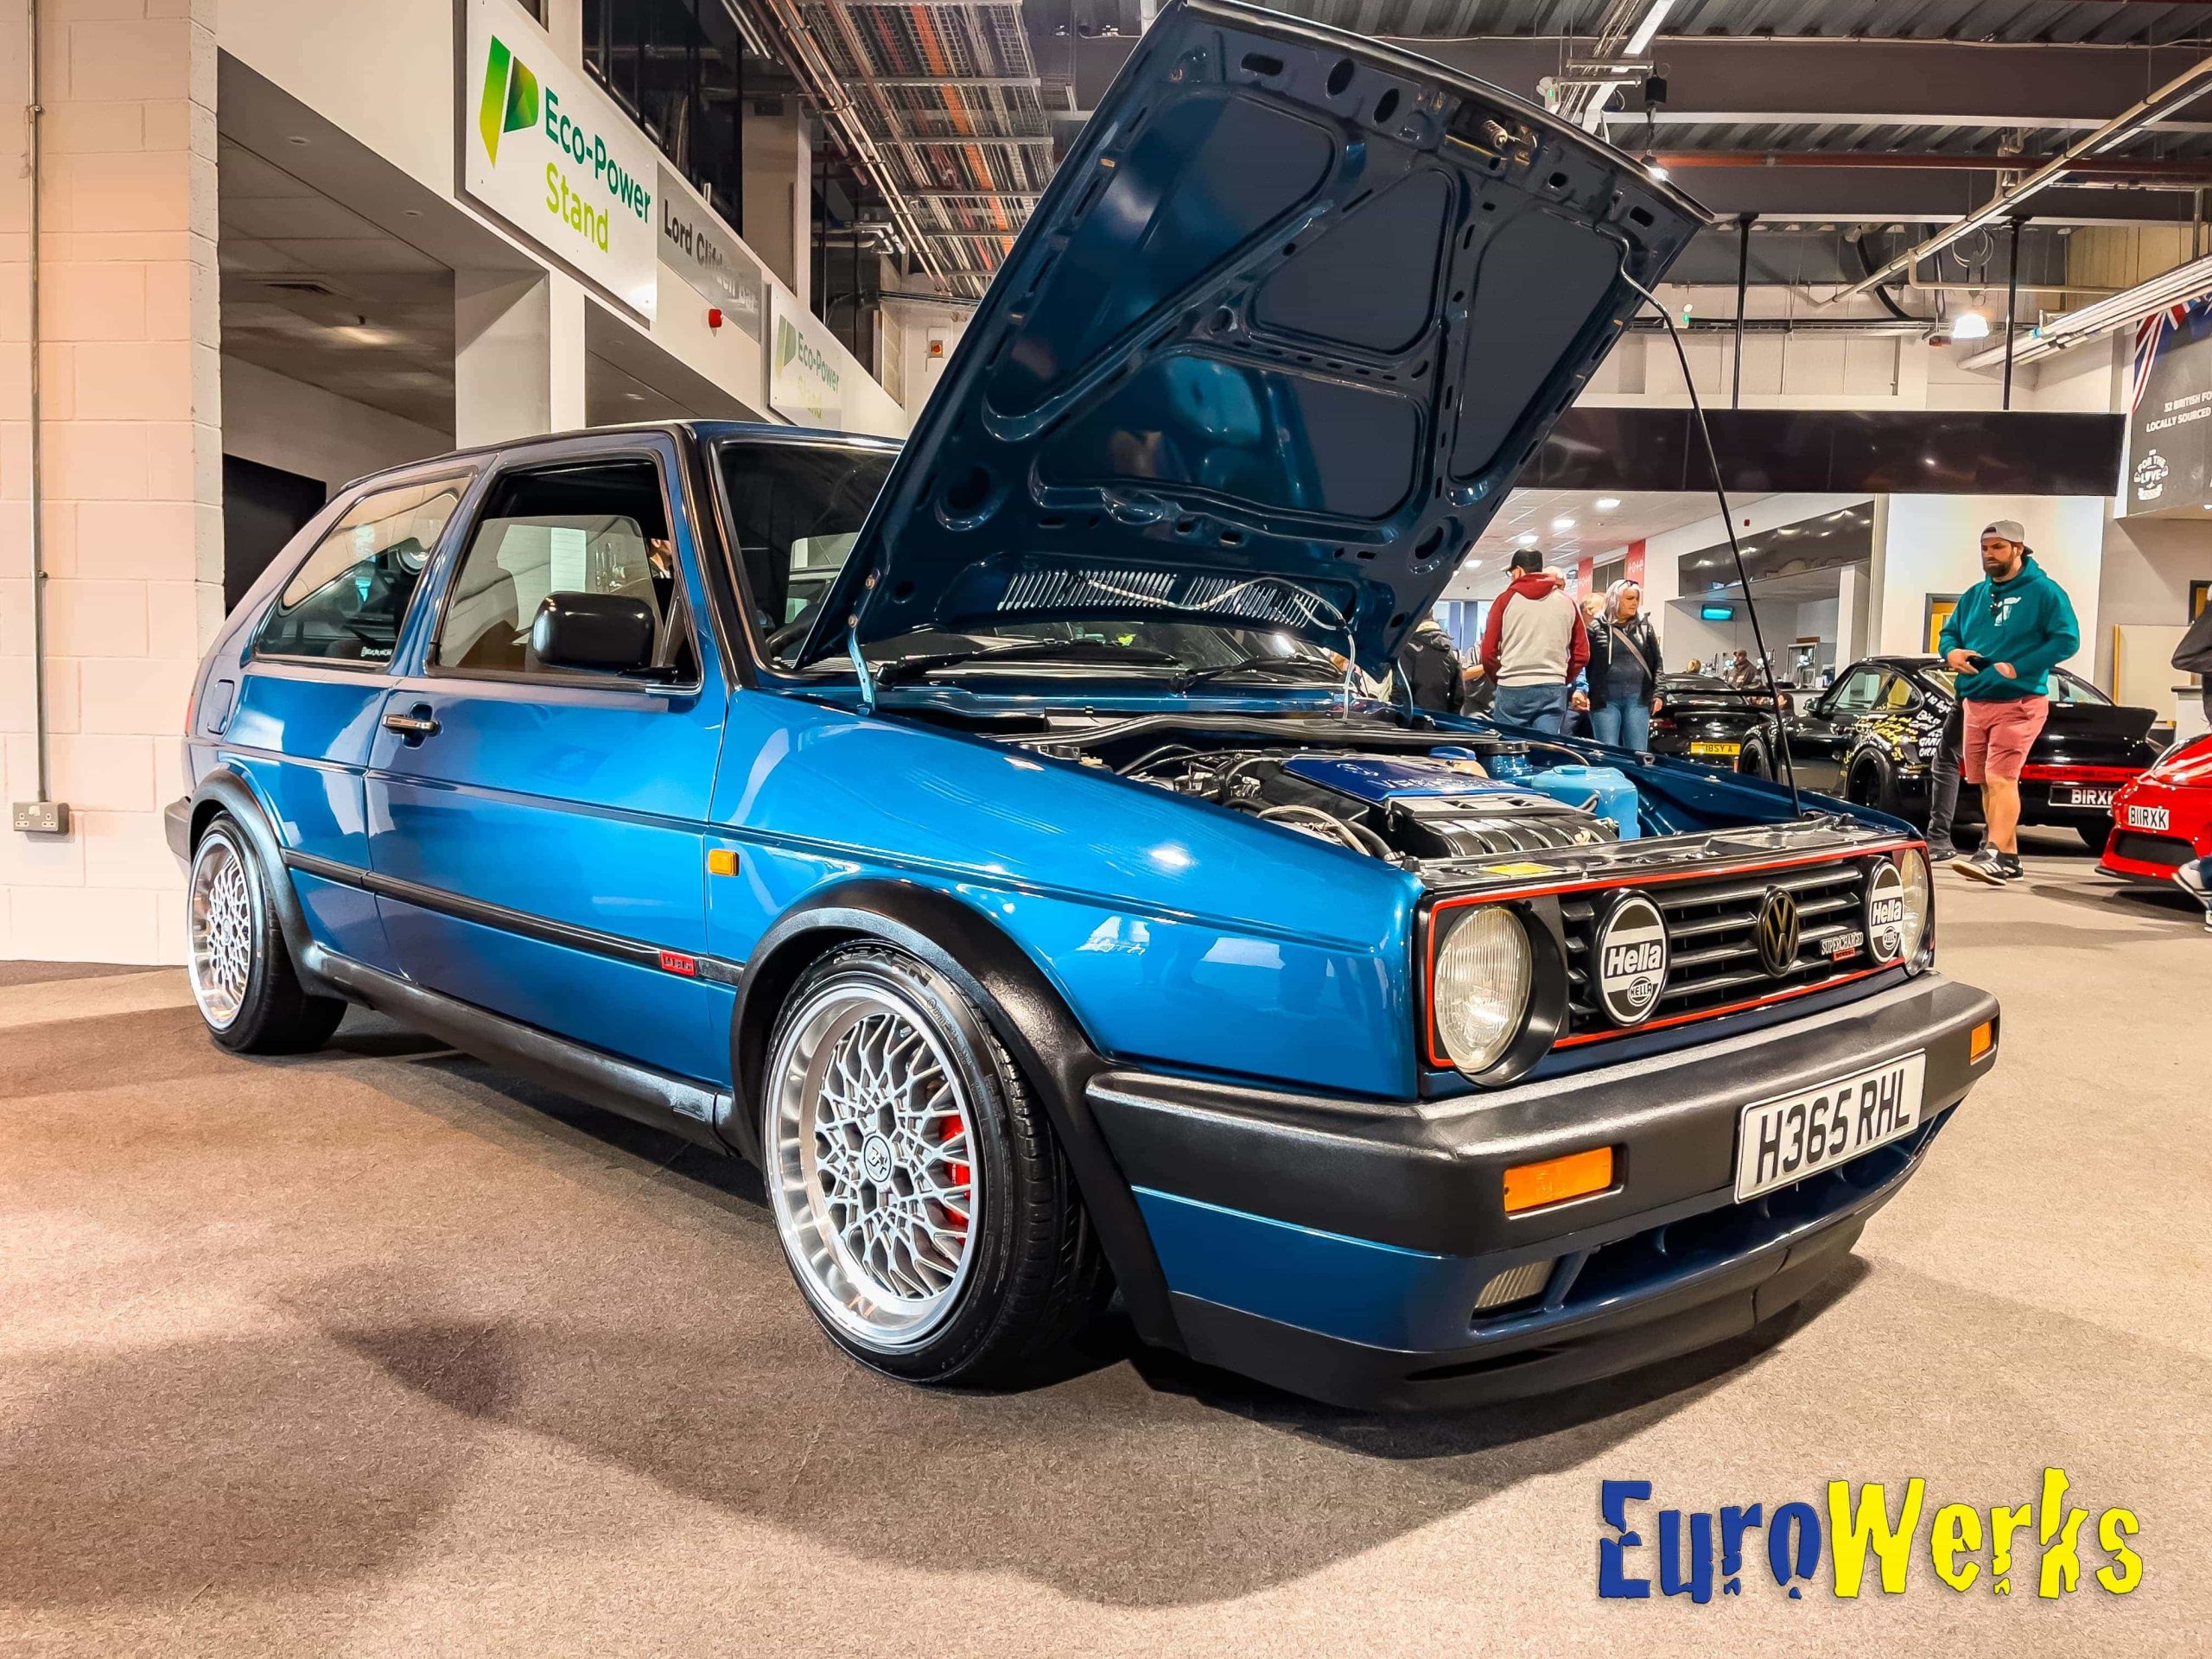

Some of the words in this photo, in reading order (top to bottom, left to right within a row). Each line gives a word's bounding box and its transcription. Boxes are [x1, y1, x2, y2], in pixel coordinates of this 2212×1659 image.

[546, 86, 651, 224] Eco-Power
[546, 162, 608, 253] Stand
[664, 199, 693, 256] Lord
[798, 332, 839, 394] Eco-Power
[2146, 416, 2177, 432] LOCALLY
[2177, 406, 2211, 424] SOURCED
[1872, 899, 1902, 926] Hella
[1607, 942, 1662, 976] Hella
[1630, 982, 1652, 996] HELLA
[1755, 1087, 1853, 1186] H365
[1856, 1068, 1910, 1148] RHL
